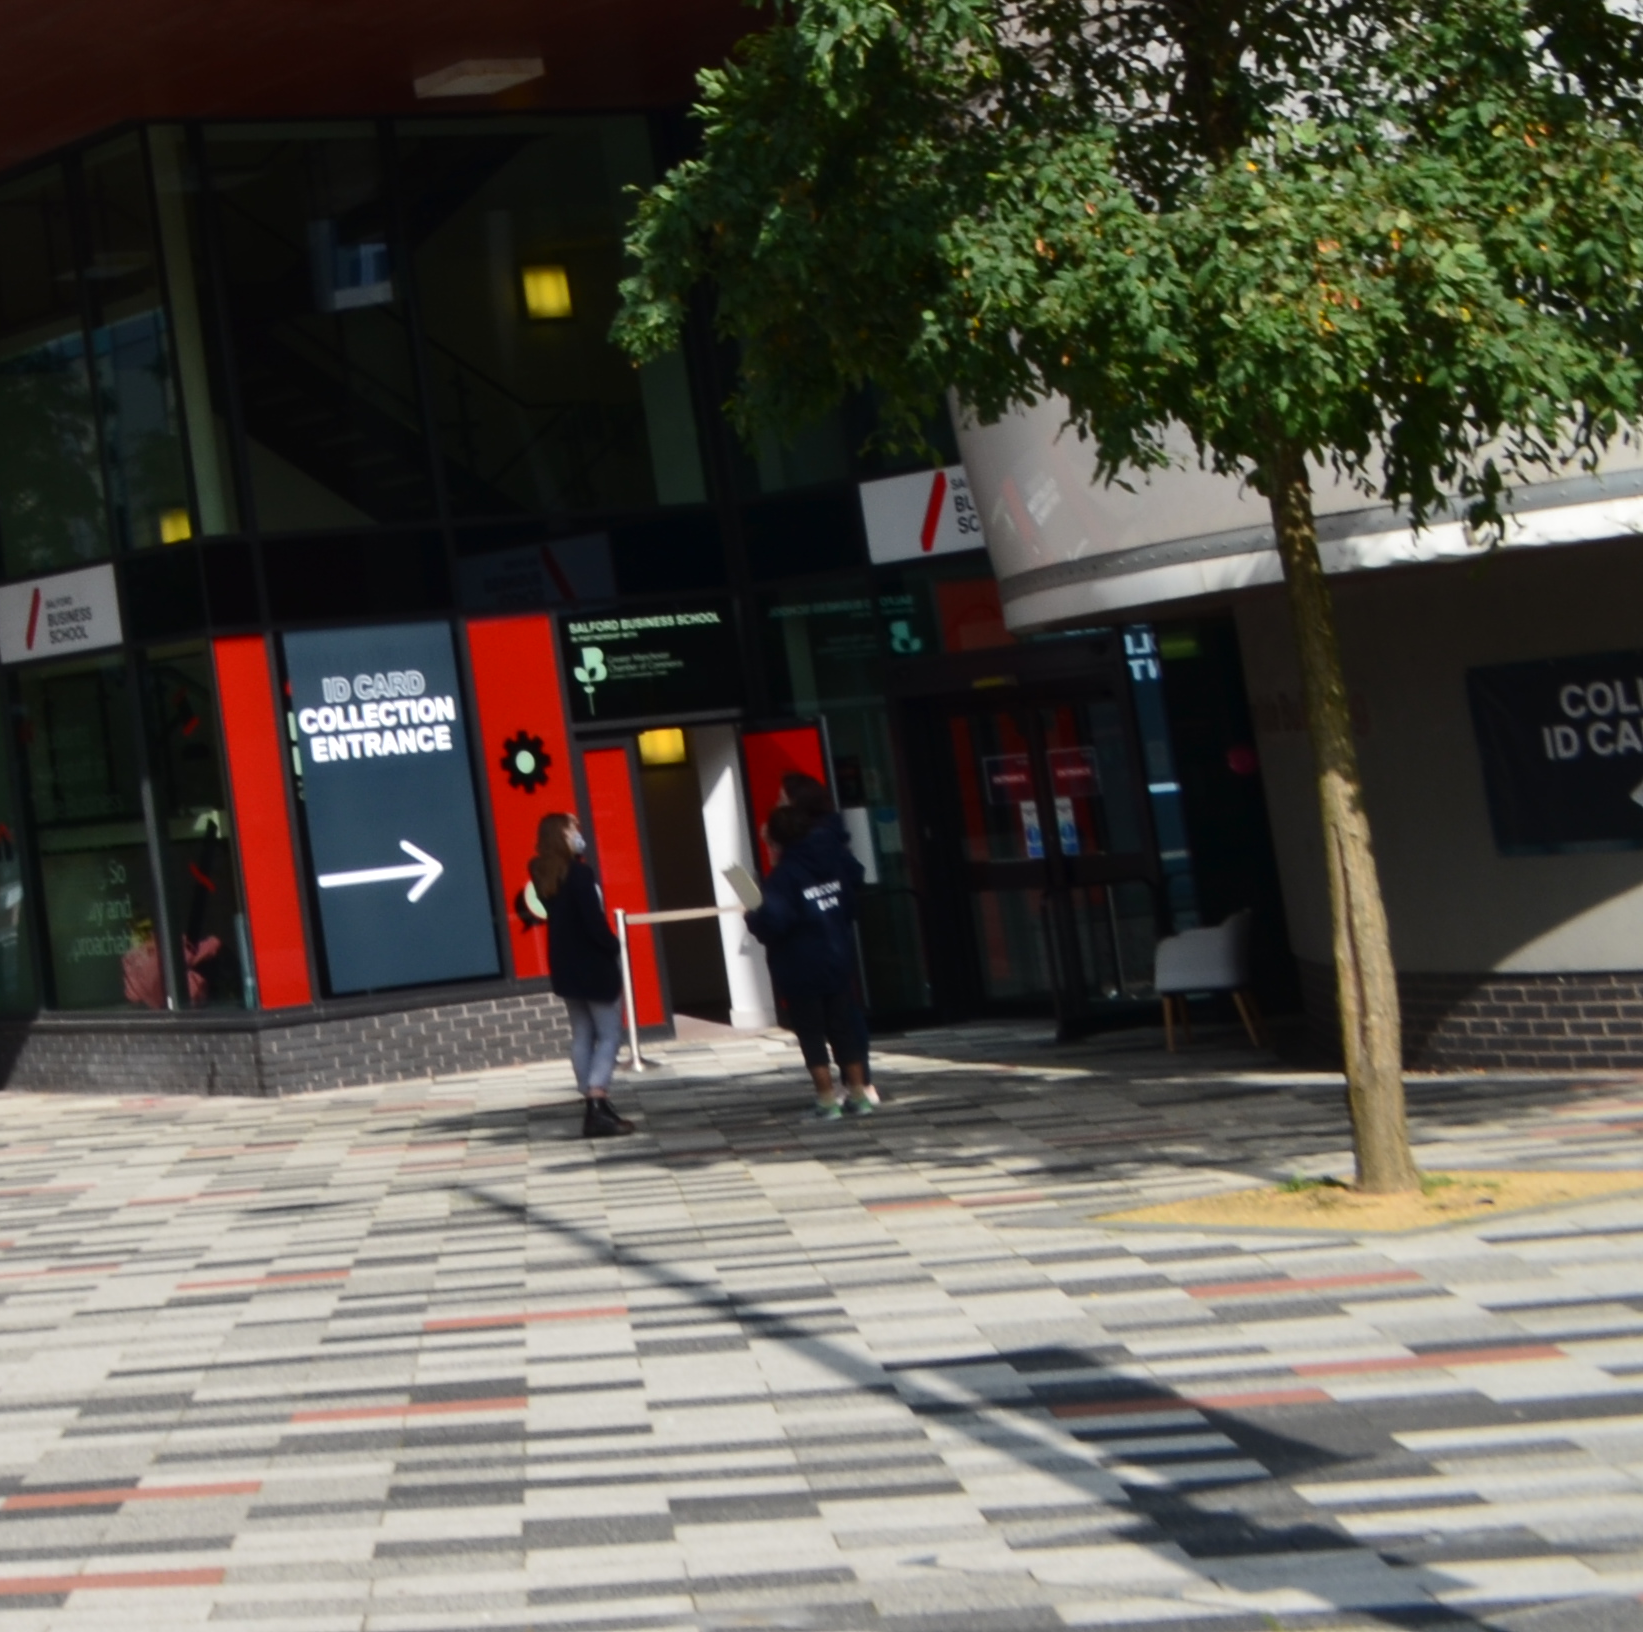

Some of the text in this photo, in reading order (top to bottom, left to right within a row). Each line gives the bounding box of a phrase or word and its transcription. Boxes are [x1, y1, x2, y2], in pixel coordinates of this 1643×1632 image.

[47, 606, 92, 627] BUSINESS
[568, 611, 721, 634] SALFORD BUSINESS SCHOOL
[49, 625, 88, 644] SCHOOL
[321, 669, 426, 704] ID CARD
[297, 695, 456, 734] COLLECTION
[310, 724, 453, 763] ENTRANCE
[1541, 723, 1581, 761] ID
